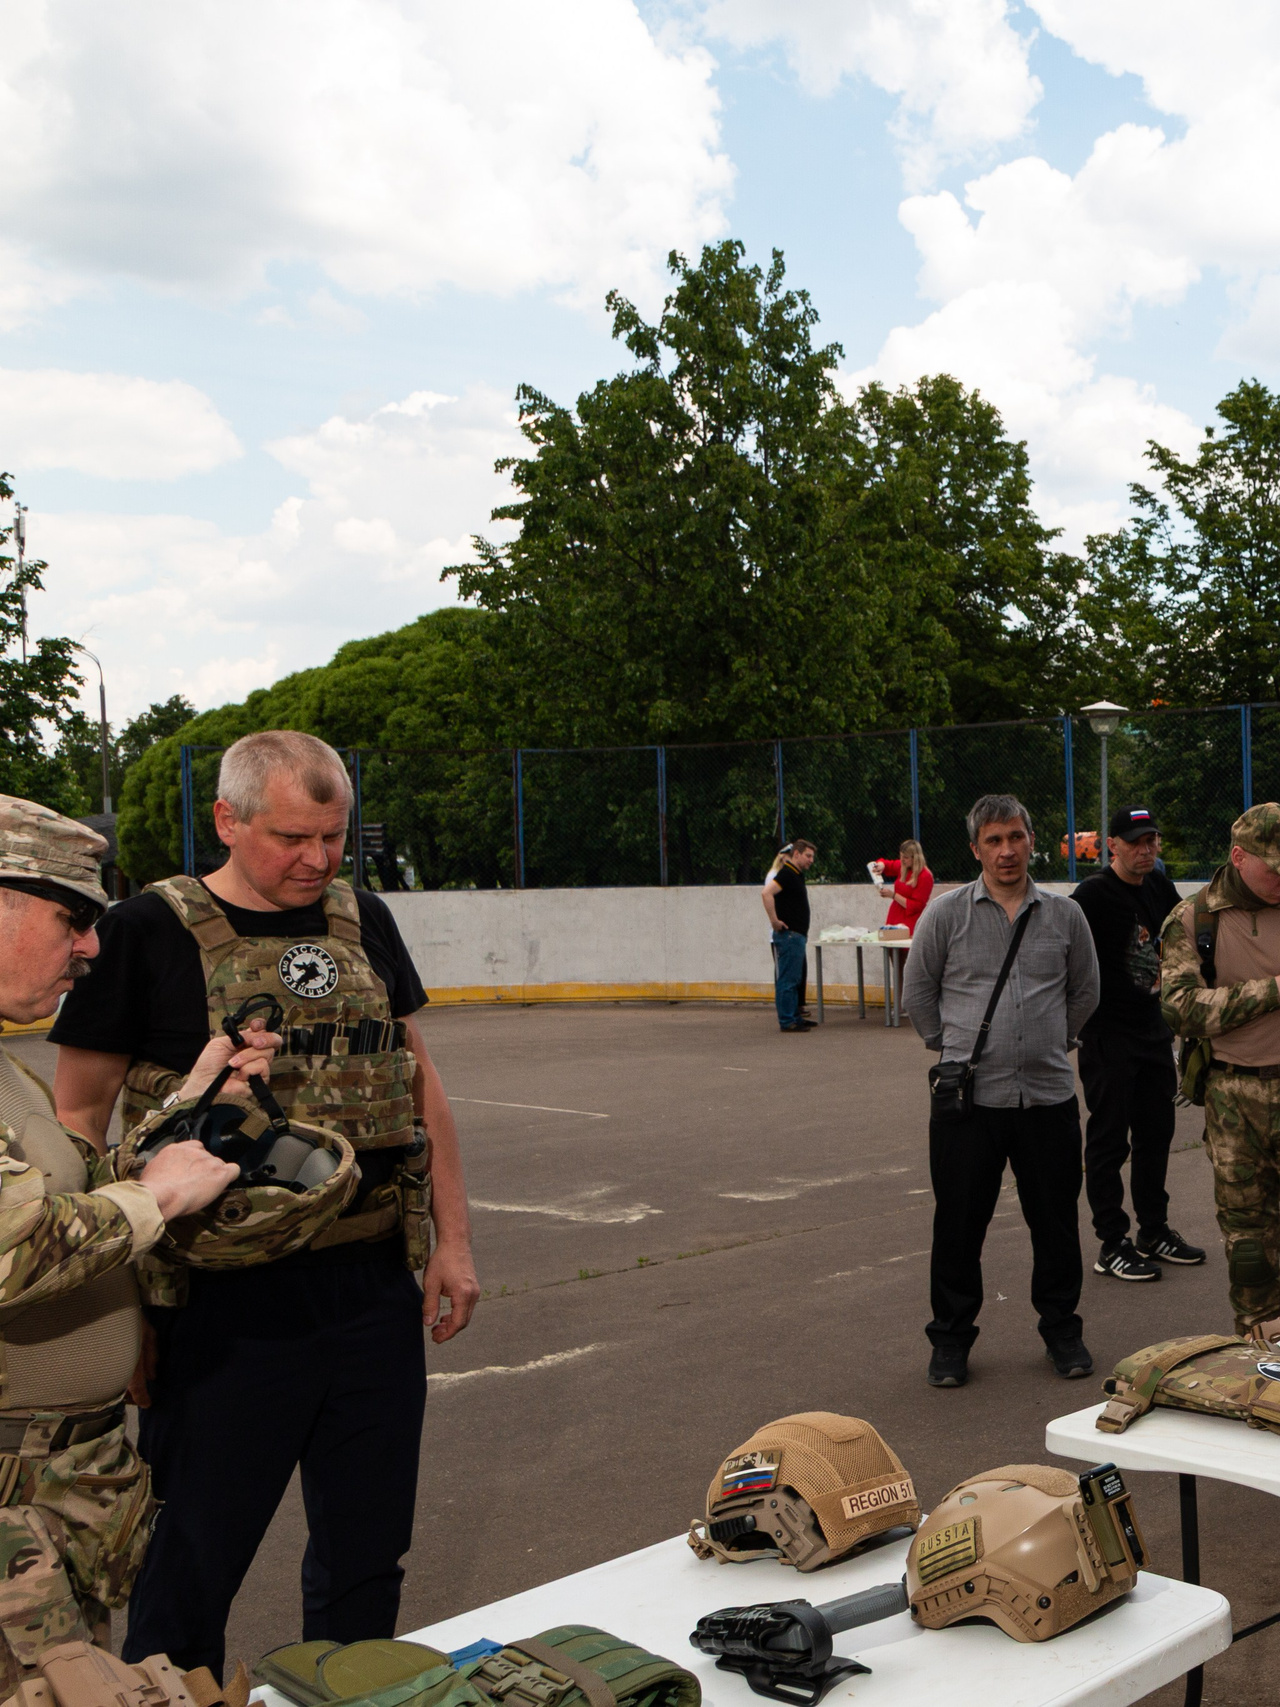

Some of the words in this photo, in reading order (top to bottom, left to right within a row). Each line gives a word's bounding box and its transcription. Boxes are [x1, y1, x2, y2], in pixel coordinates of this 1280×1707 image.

[286, 946, 335, 970] РУССКАЯ
[284, 975, 330, 996] ОБЩИНА
[849, 1487, 899, 1513] REGION
[901, 1482, 911, 1499] 51
[920, 1523, 970, 1555] RUSSIA
